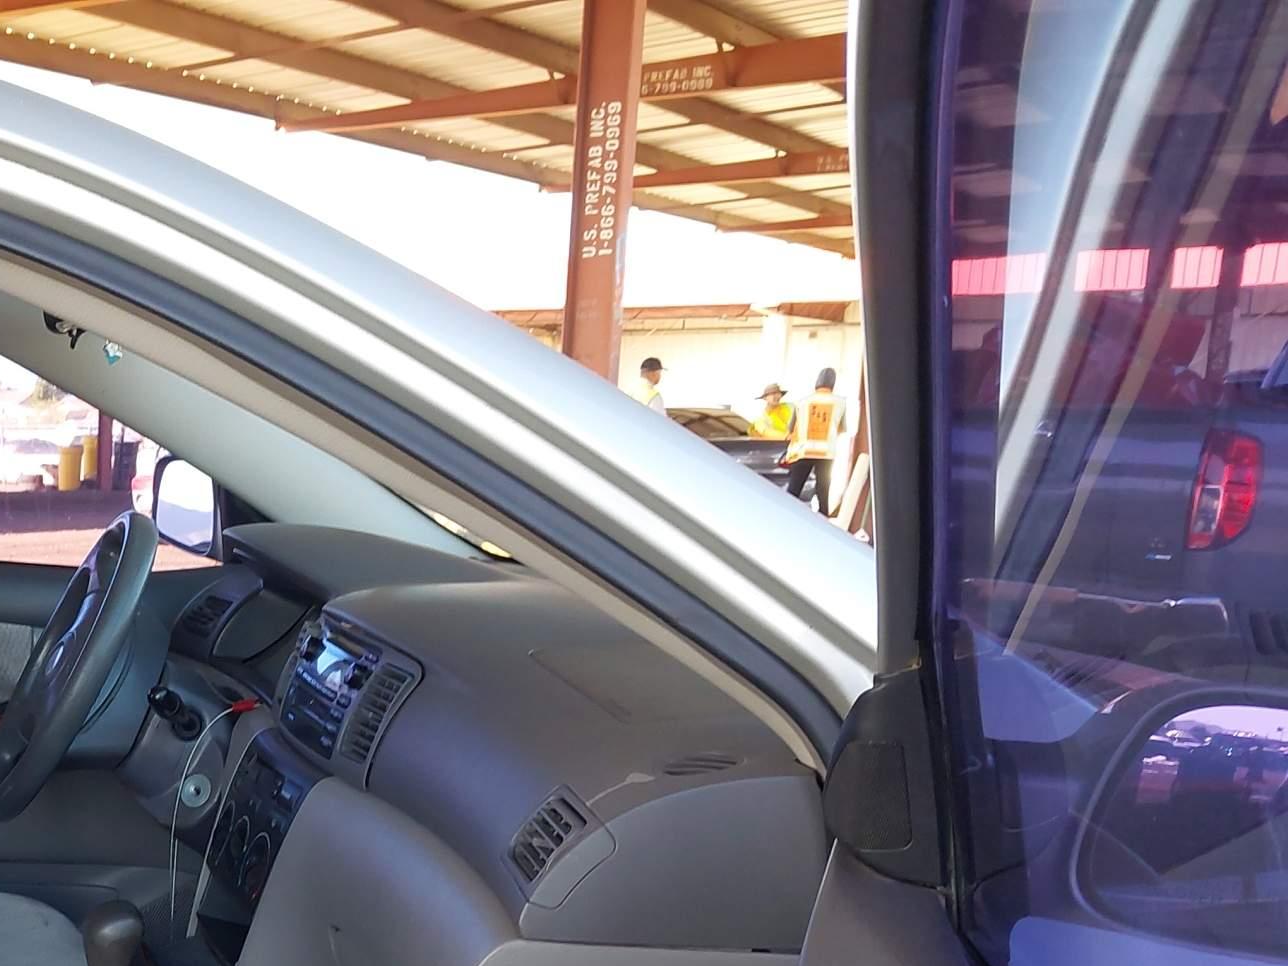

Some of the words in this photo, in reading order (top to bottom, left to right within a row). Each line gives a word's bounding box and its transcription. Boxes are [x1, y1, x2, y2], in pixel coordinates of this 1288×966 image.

[589, 101, 607, 138] INC.
[585, 145, 603, 216] PREFAB
[598, 101, 623, 256] 1-866-799-0969
[582, 224, 598, 259] U.S.
